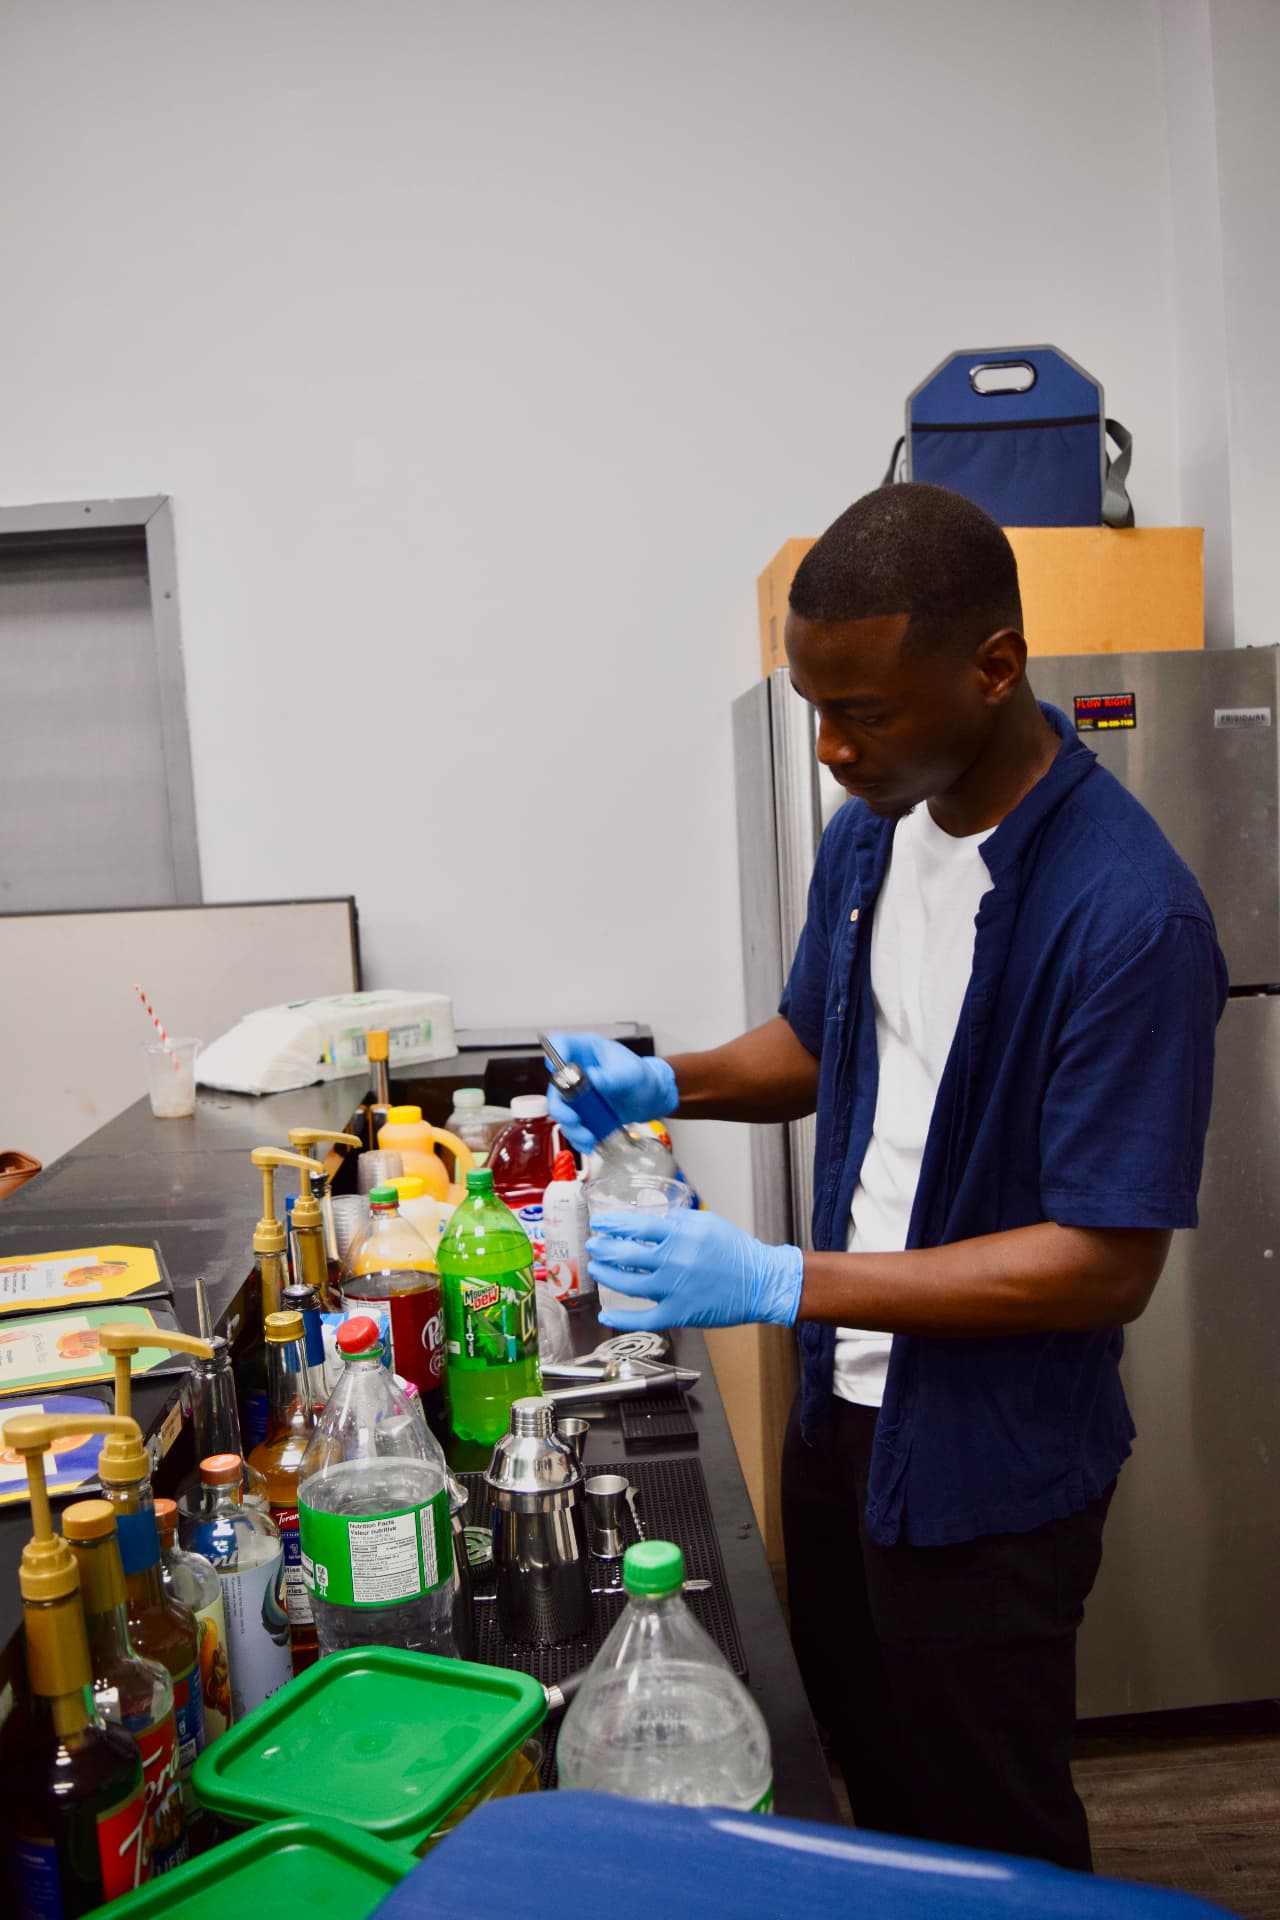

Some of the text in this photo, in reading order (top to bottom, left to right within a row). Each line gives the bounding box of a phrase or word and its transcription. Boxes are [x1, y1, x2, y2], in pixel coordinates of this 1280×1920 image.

[1076, 699, 1101, 709] FLOW
[1104, 697, 1132, 708] RIGHT
[1220, 713, 1265, 722] FRIGIDAIRE
[276, 1511, 300, 1525] Toran
[371, 1526, 397, 1535] nutritive
